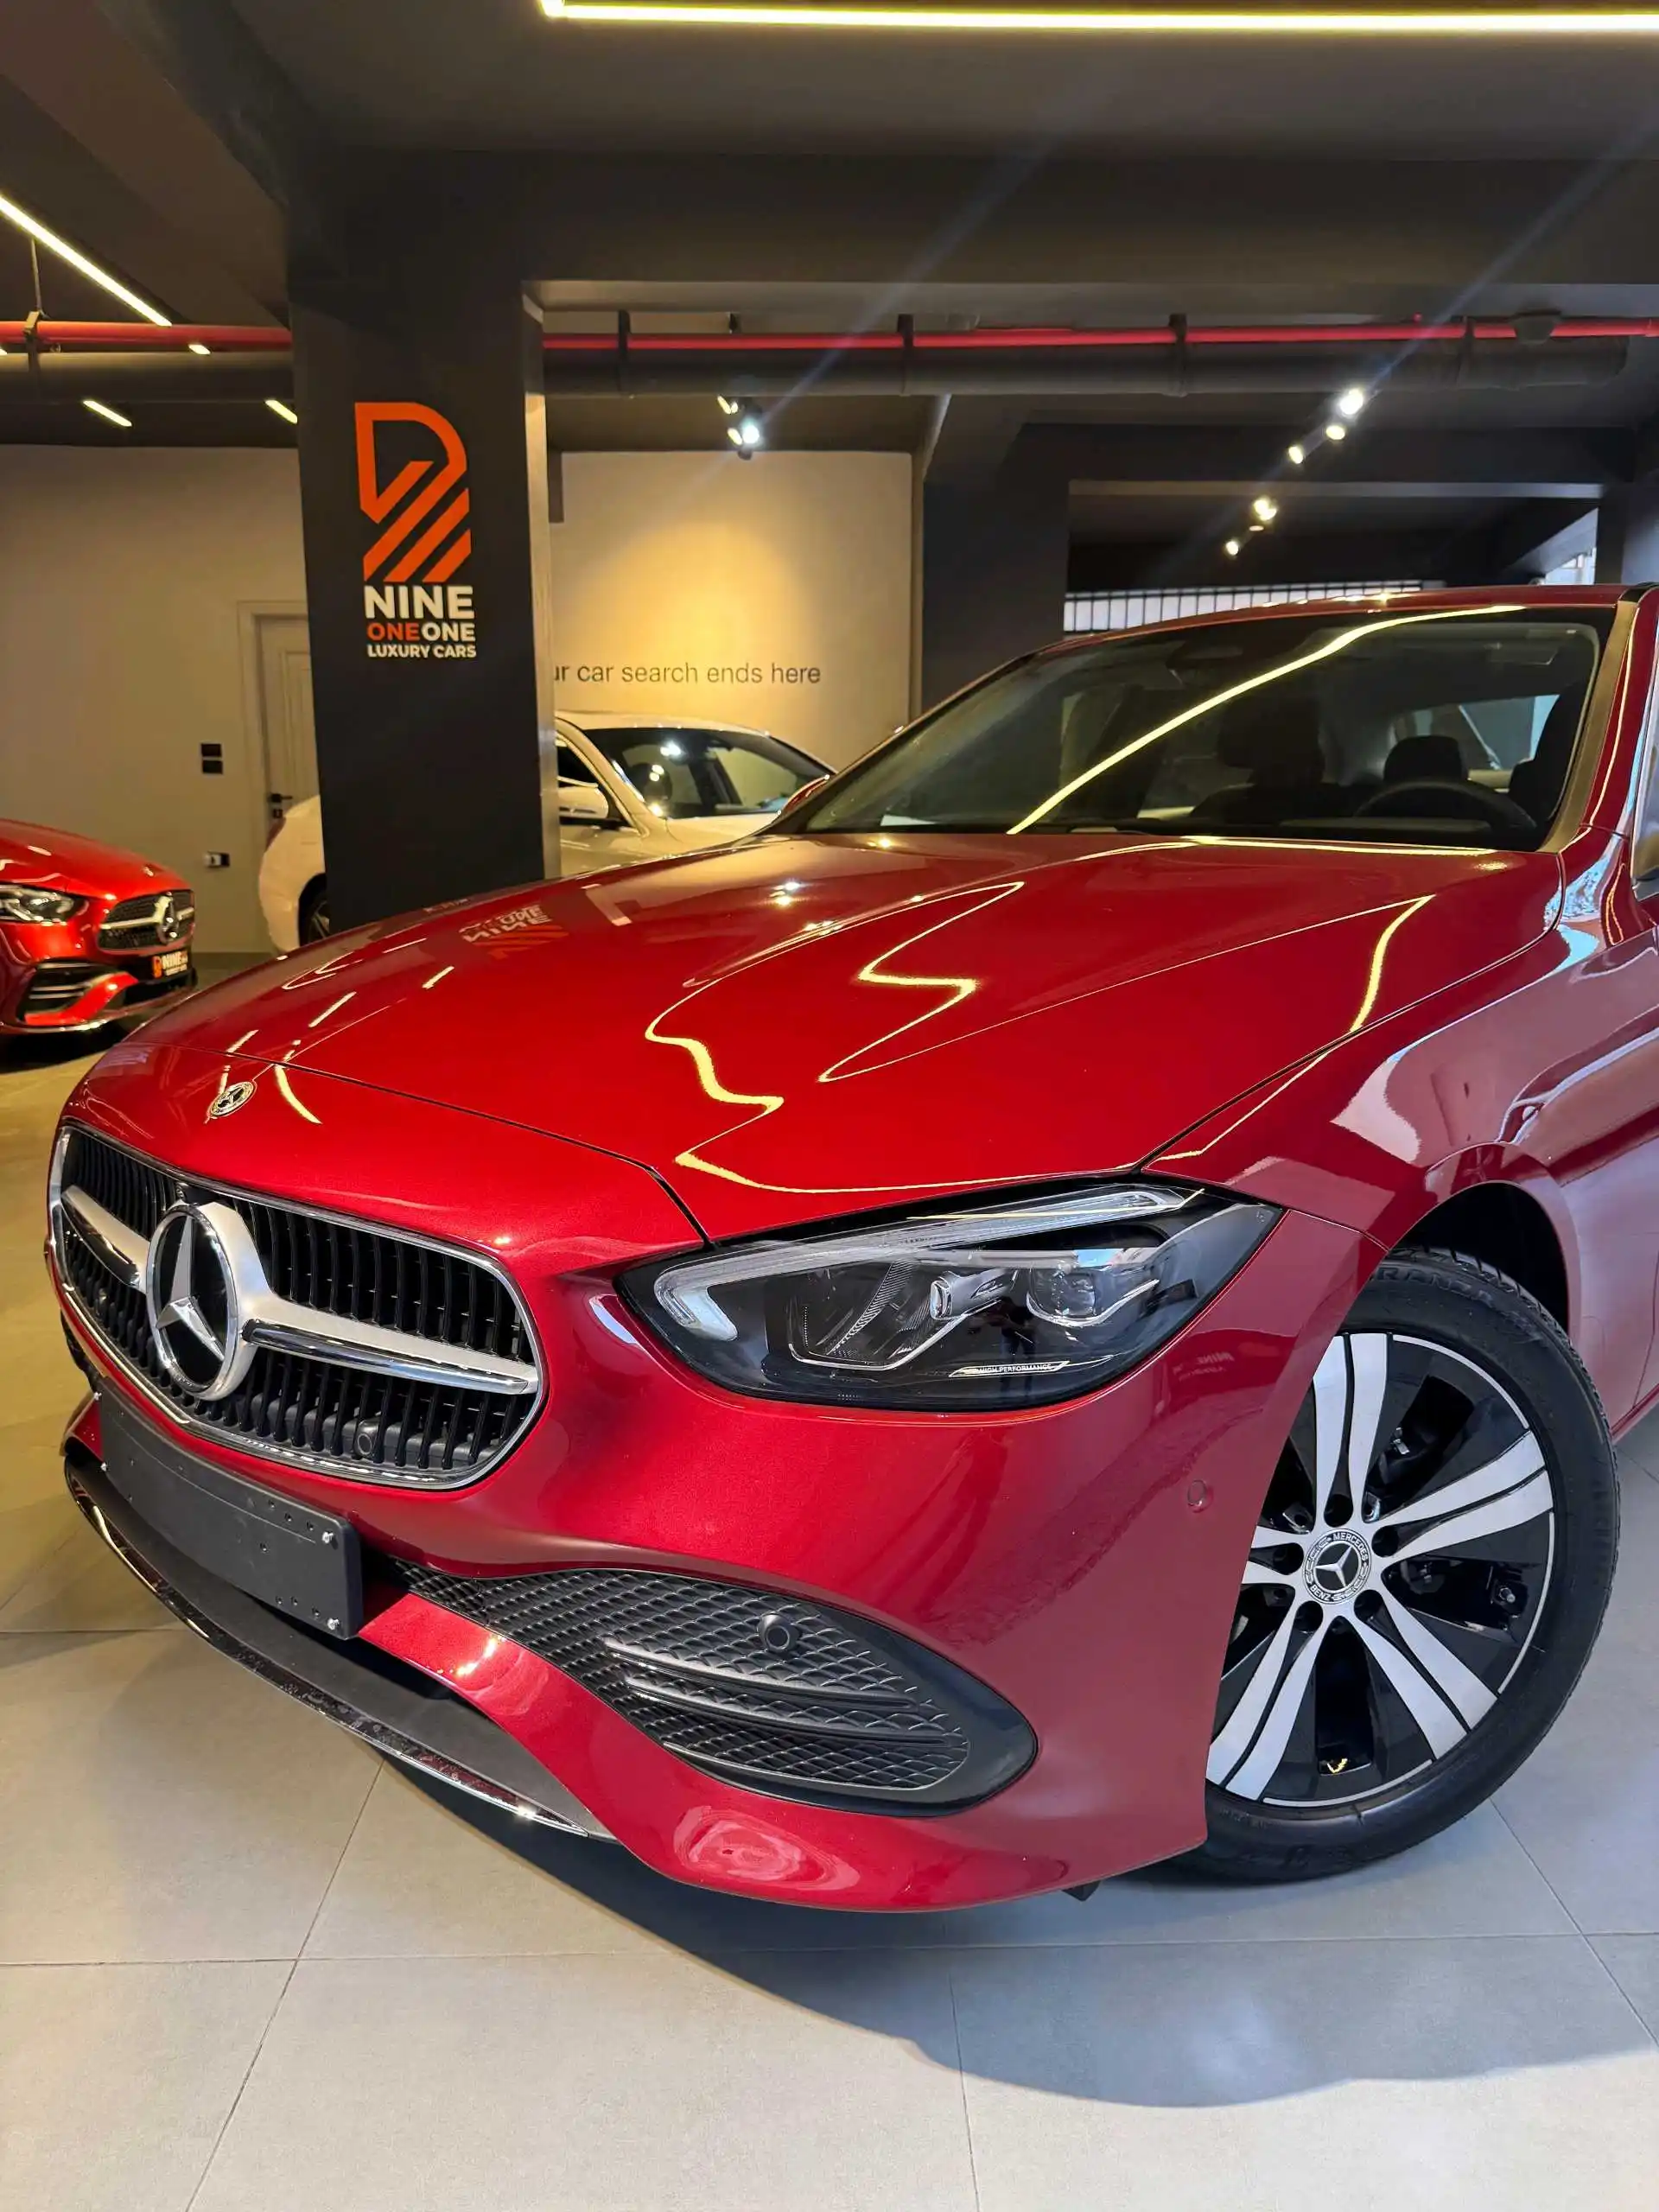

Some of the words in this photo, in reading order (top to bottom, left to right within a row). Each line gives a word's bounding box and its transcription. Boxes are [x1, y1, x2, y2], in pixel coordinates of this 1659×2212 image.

[364, 585, 475, 620] NINE
[367, 645, 430, 658] LUXURY
[433, 644, 477, 658] CARS
[576, 664, 614, 683] car
[621, 662, 699, 683] search
[707, 663, 764, 683] ends
[772, 663, 822, 684] here
[1332, 1532, 1369, 1561] MERCEDES
[1310, 1585, 1332, 1602] BENZ
